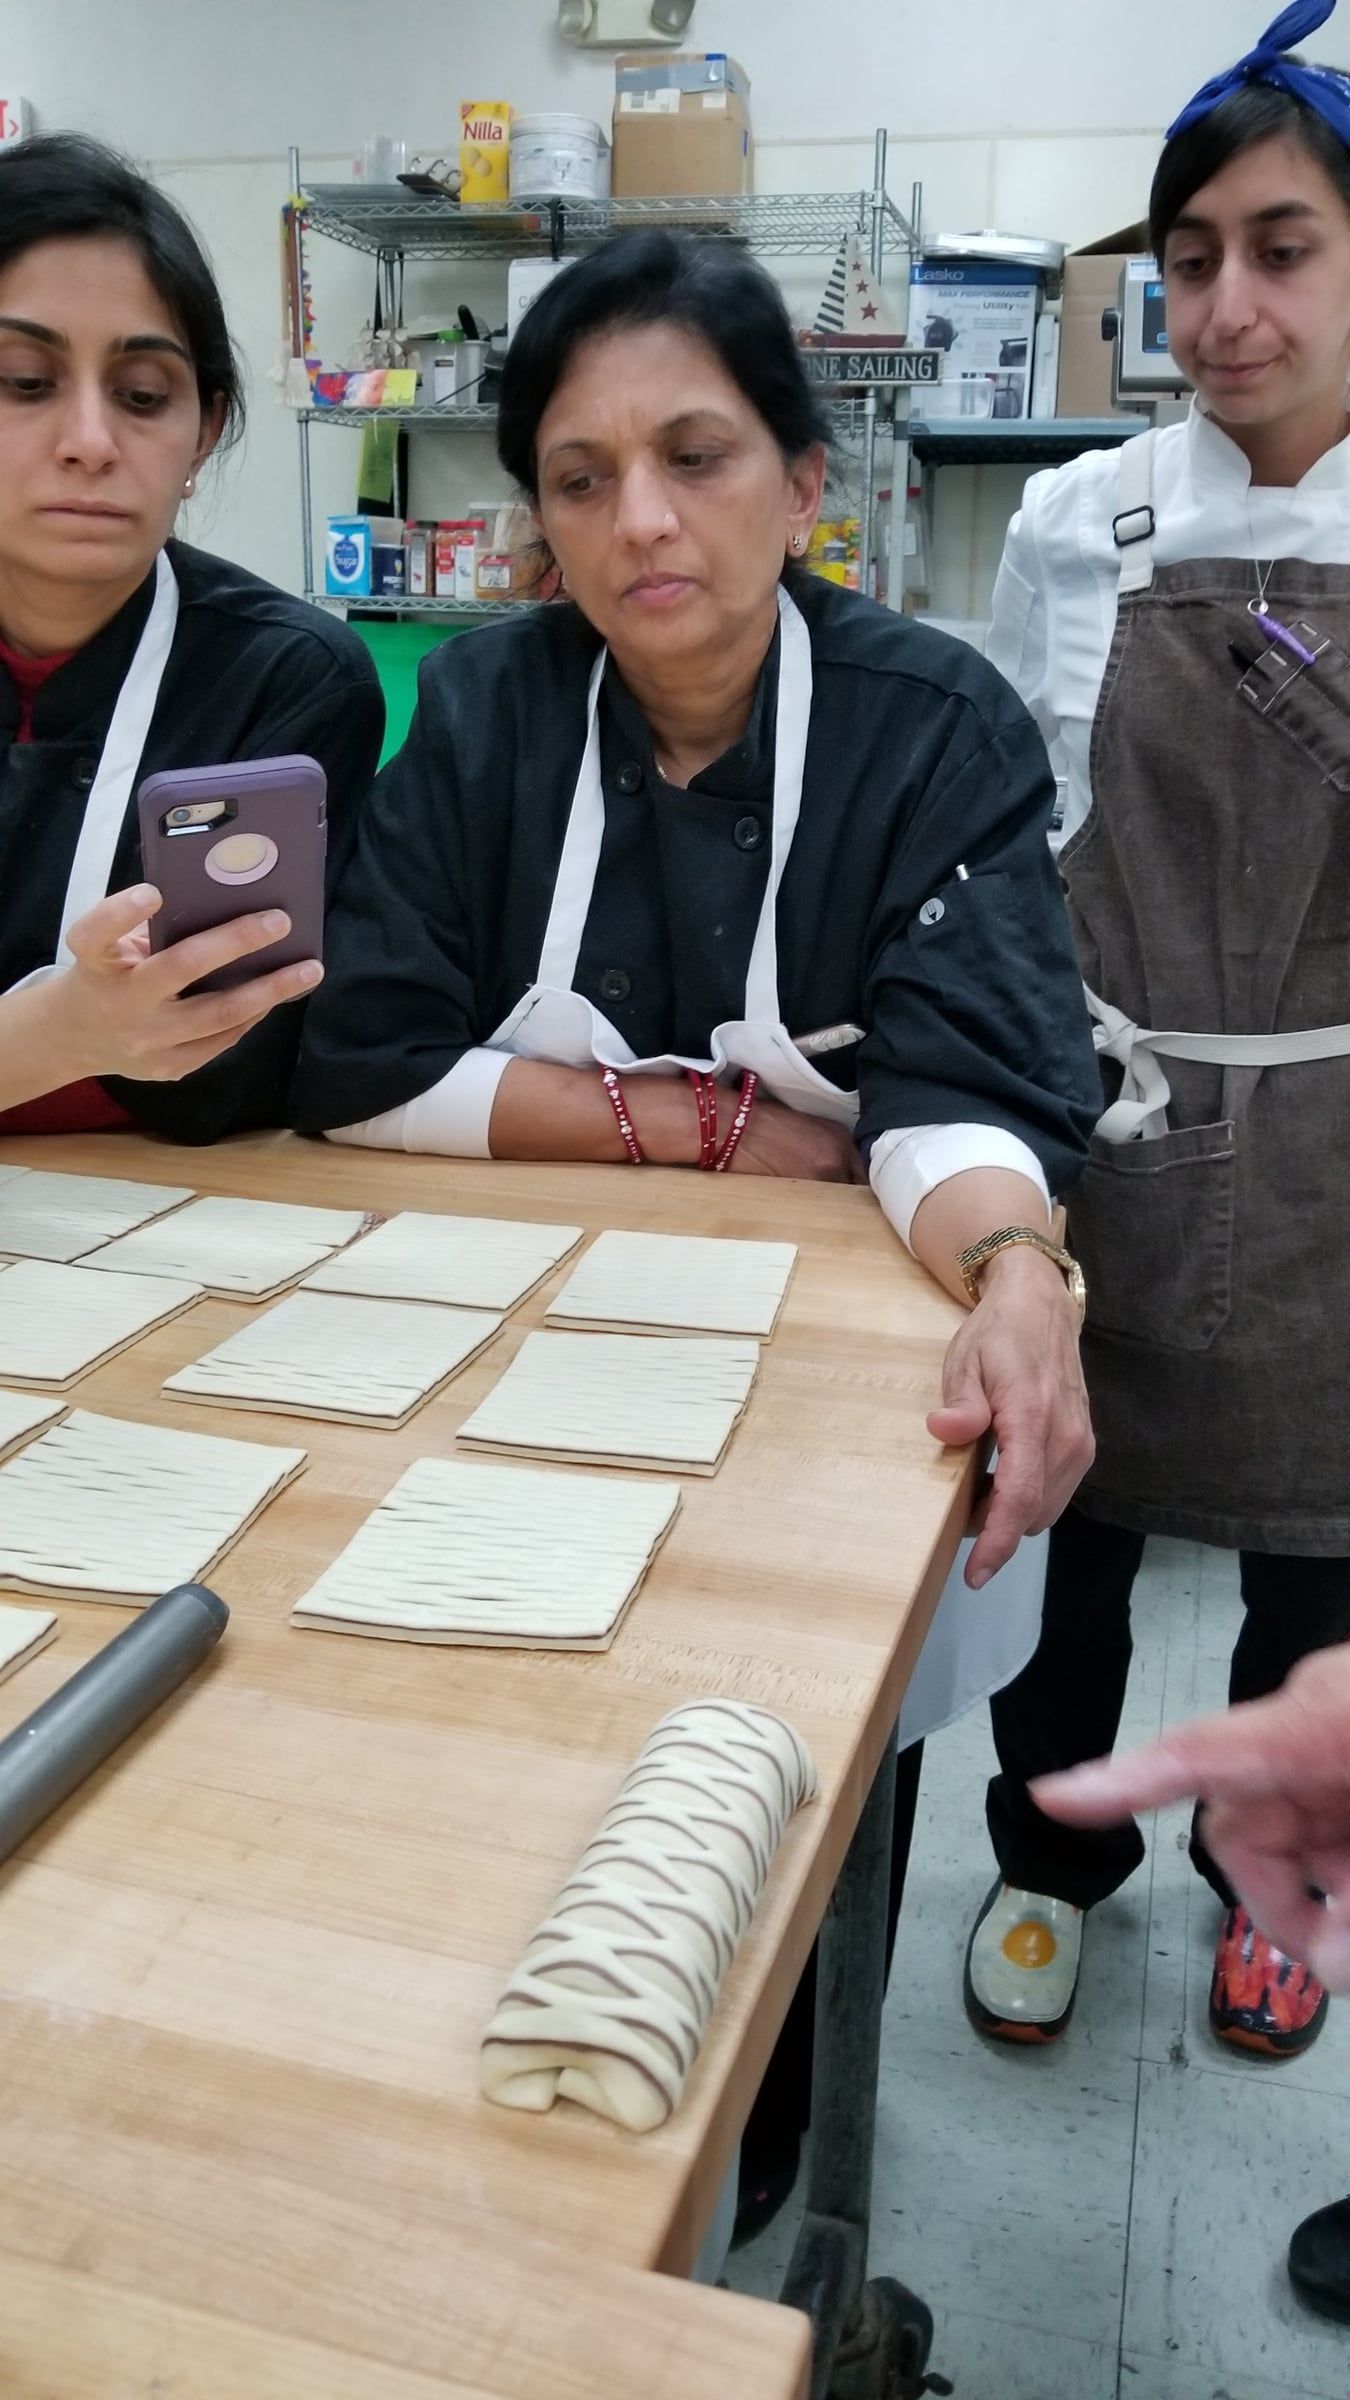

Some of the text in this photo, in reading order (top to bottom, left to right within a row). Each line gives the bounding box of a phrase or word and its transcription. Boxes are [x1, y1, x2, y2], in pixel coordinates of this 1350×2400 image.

[464, 121, 502, 140] Nilla
[915, 267, 964, 281] Lasko
[960, 290, 1031, 298] PERFORMANCE
[983, 301, 1014, 311] Utility
[847, 355, 933, 379] SAILING
